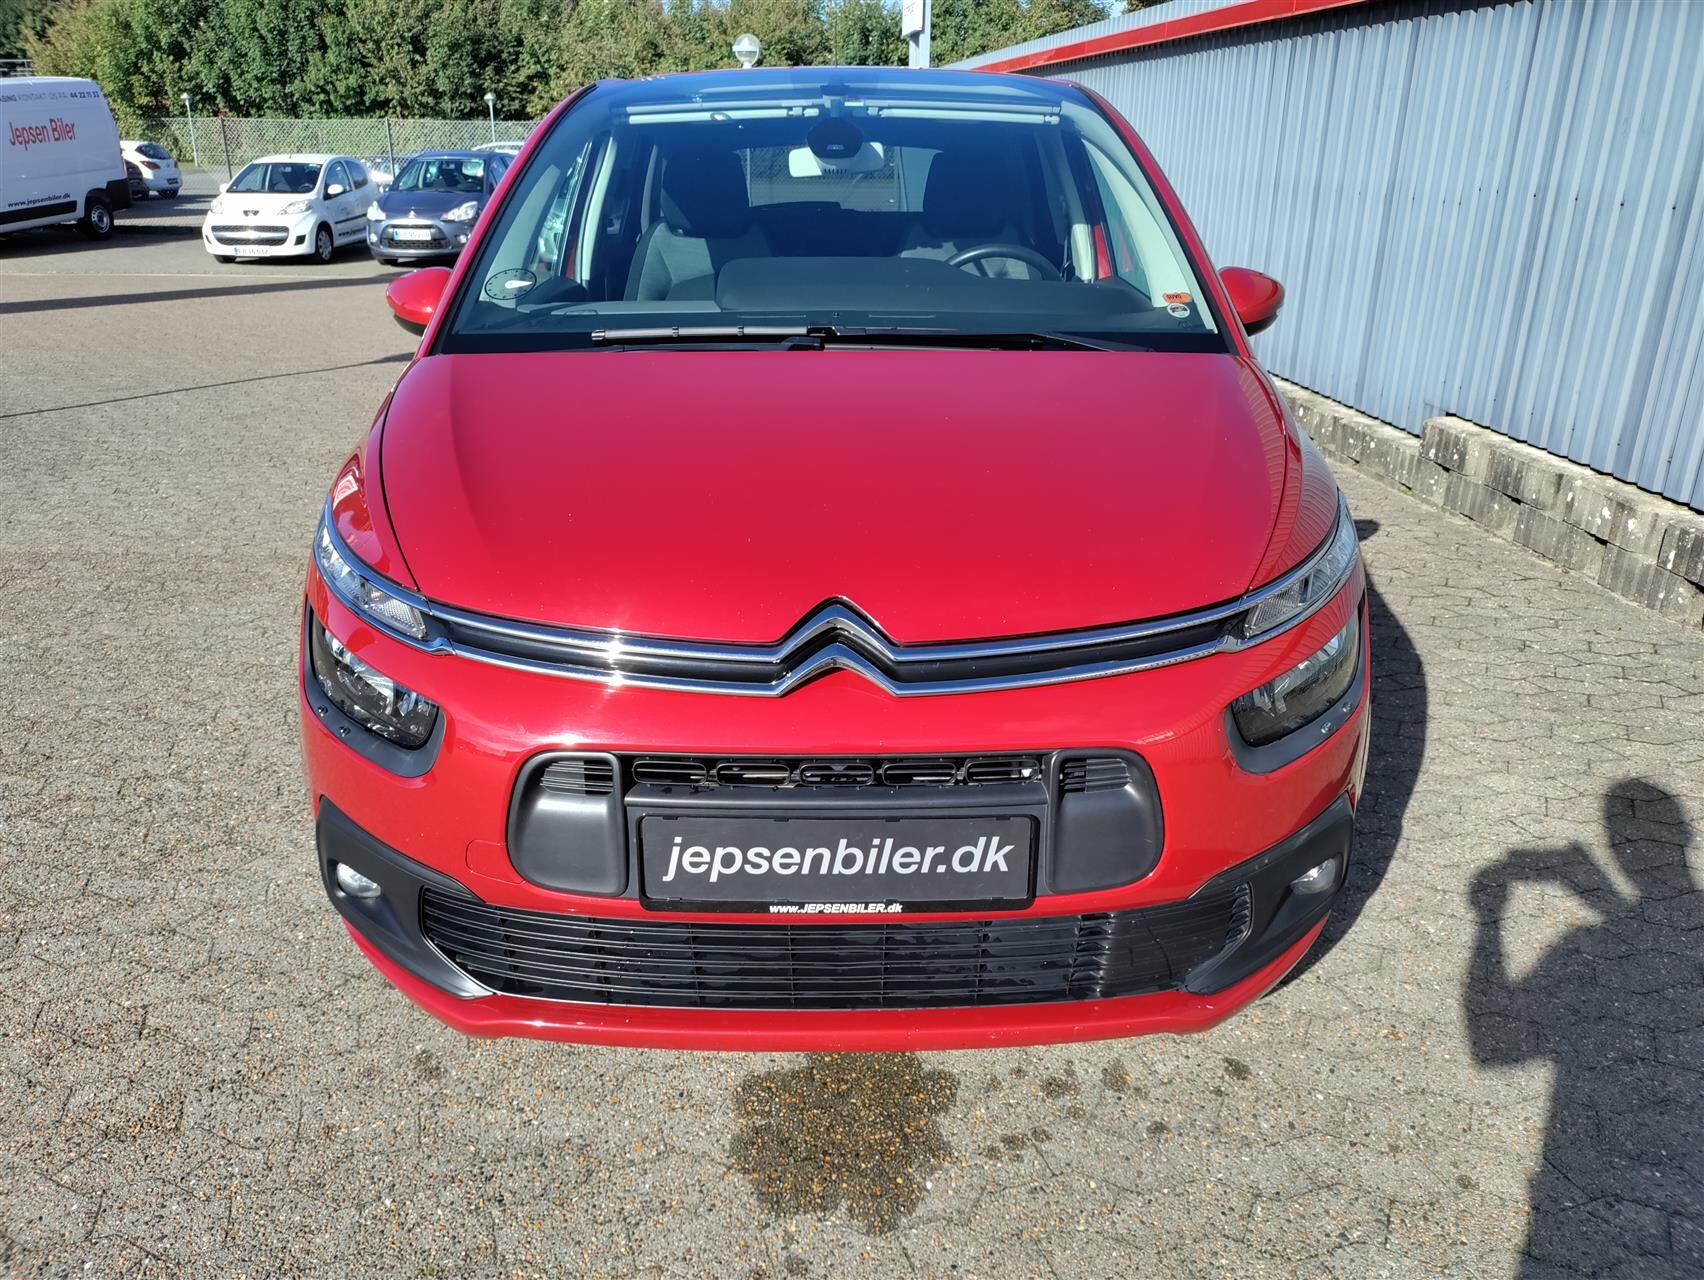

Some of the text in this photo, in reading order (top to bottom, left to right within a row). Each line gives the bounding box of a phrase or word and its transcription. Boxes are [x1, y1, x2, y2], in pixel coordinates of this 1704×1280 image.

[9, 118, 75, 150] Jepsen Biler
[8, 193, 70, 207] www.jepsenbiler.dk
[662, 836, 1015, 882] jepsenbiler.dk
[769, 903, 903, 914] www.JEPSENBILER.dk
